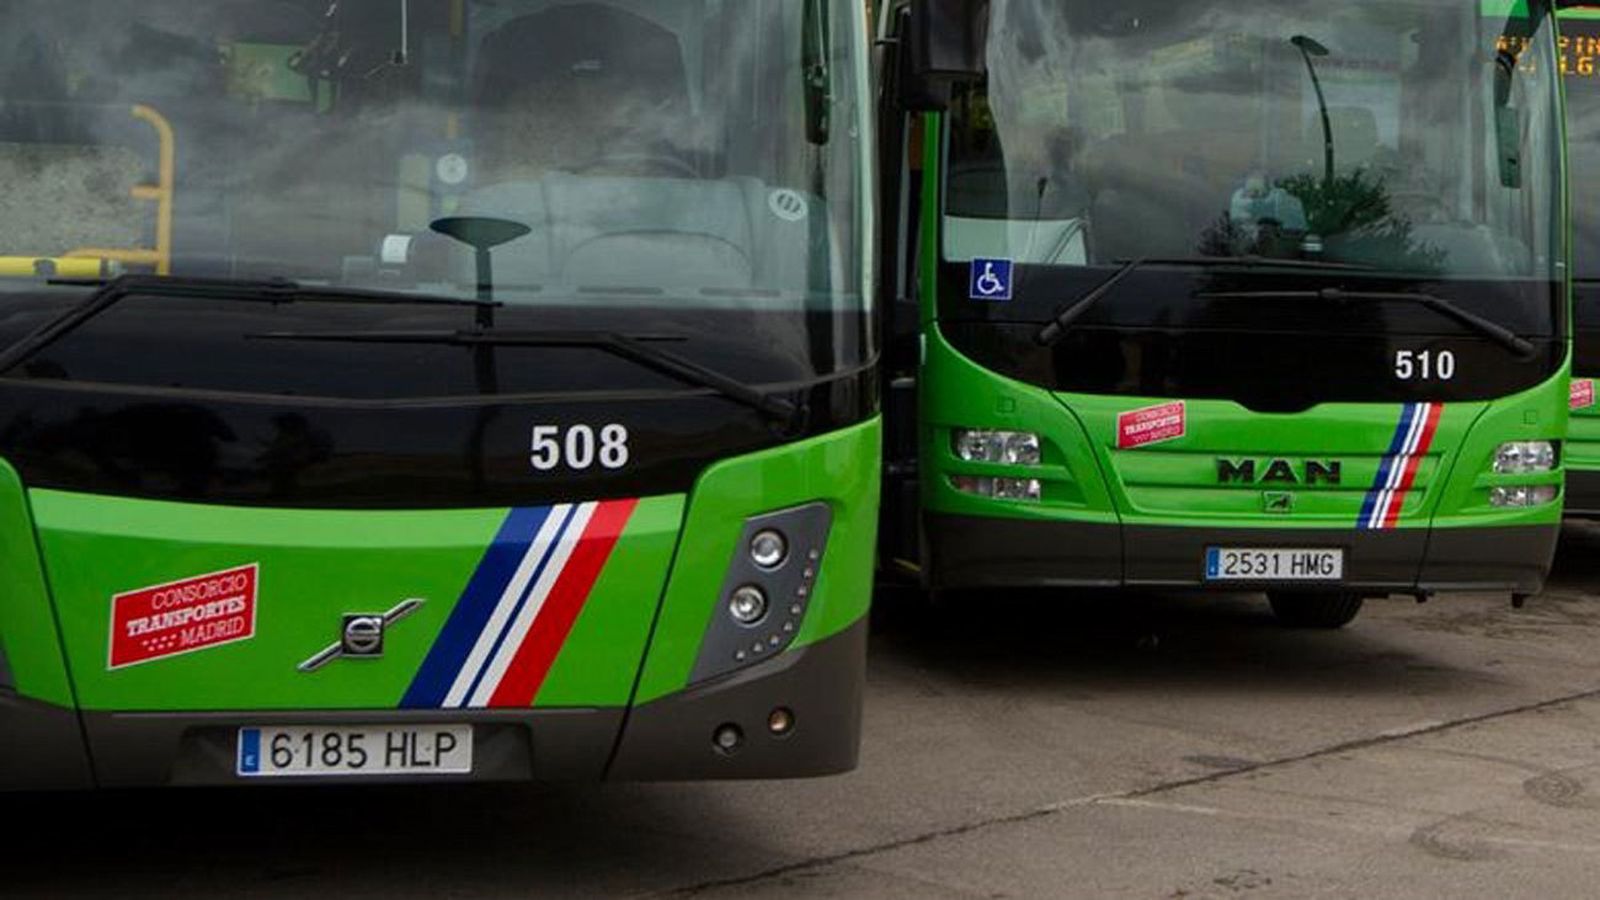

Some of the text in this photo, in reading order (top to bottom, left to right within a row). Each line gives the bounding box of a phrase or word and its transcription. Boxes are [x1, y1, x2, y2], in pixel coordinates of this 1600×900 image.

[1395, 350, 1455, 380] 510
[530, 423, 629, 470] 508
[1217, 458, 1341, 484] MAN
[1224, 552, 1334, 575] 2531 HMG
[152, 573, 248, 610] CONSORCIO
[126, 595, 247, 637] TRANSPORTES
[178, 616, 245, 647] MADRID
[270, 732, 368, 769] 6185
[384, 731, 458, 768] HLP
